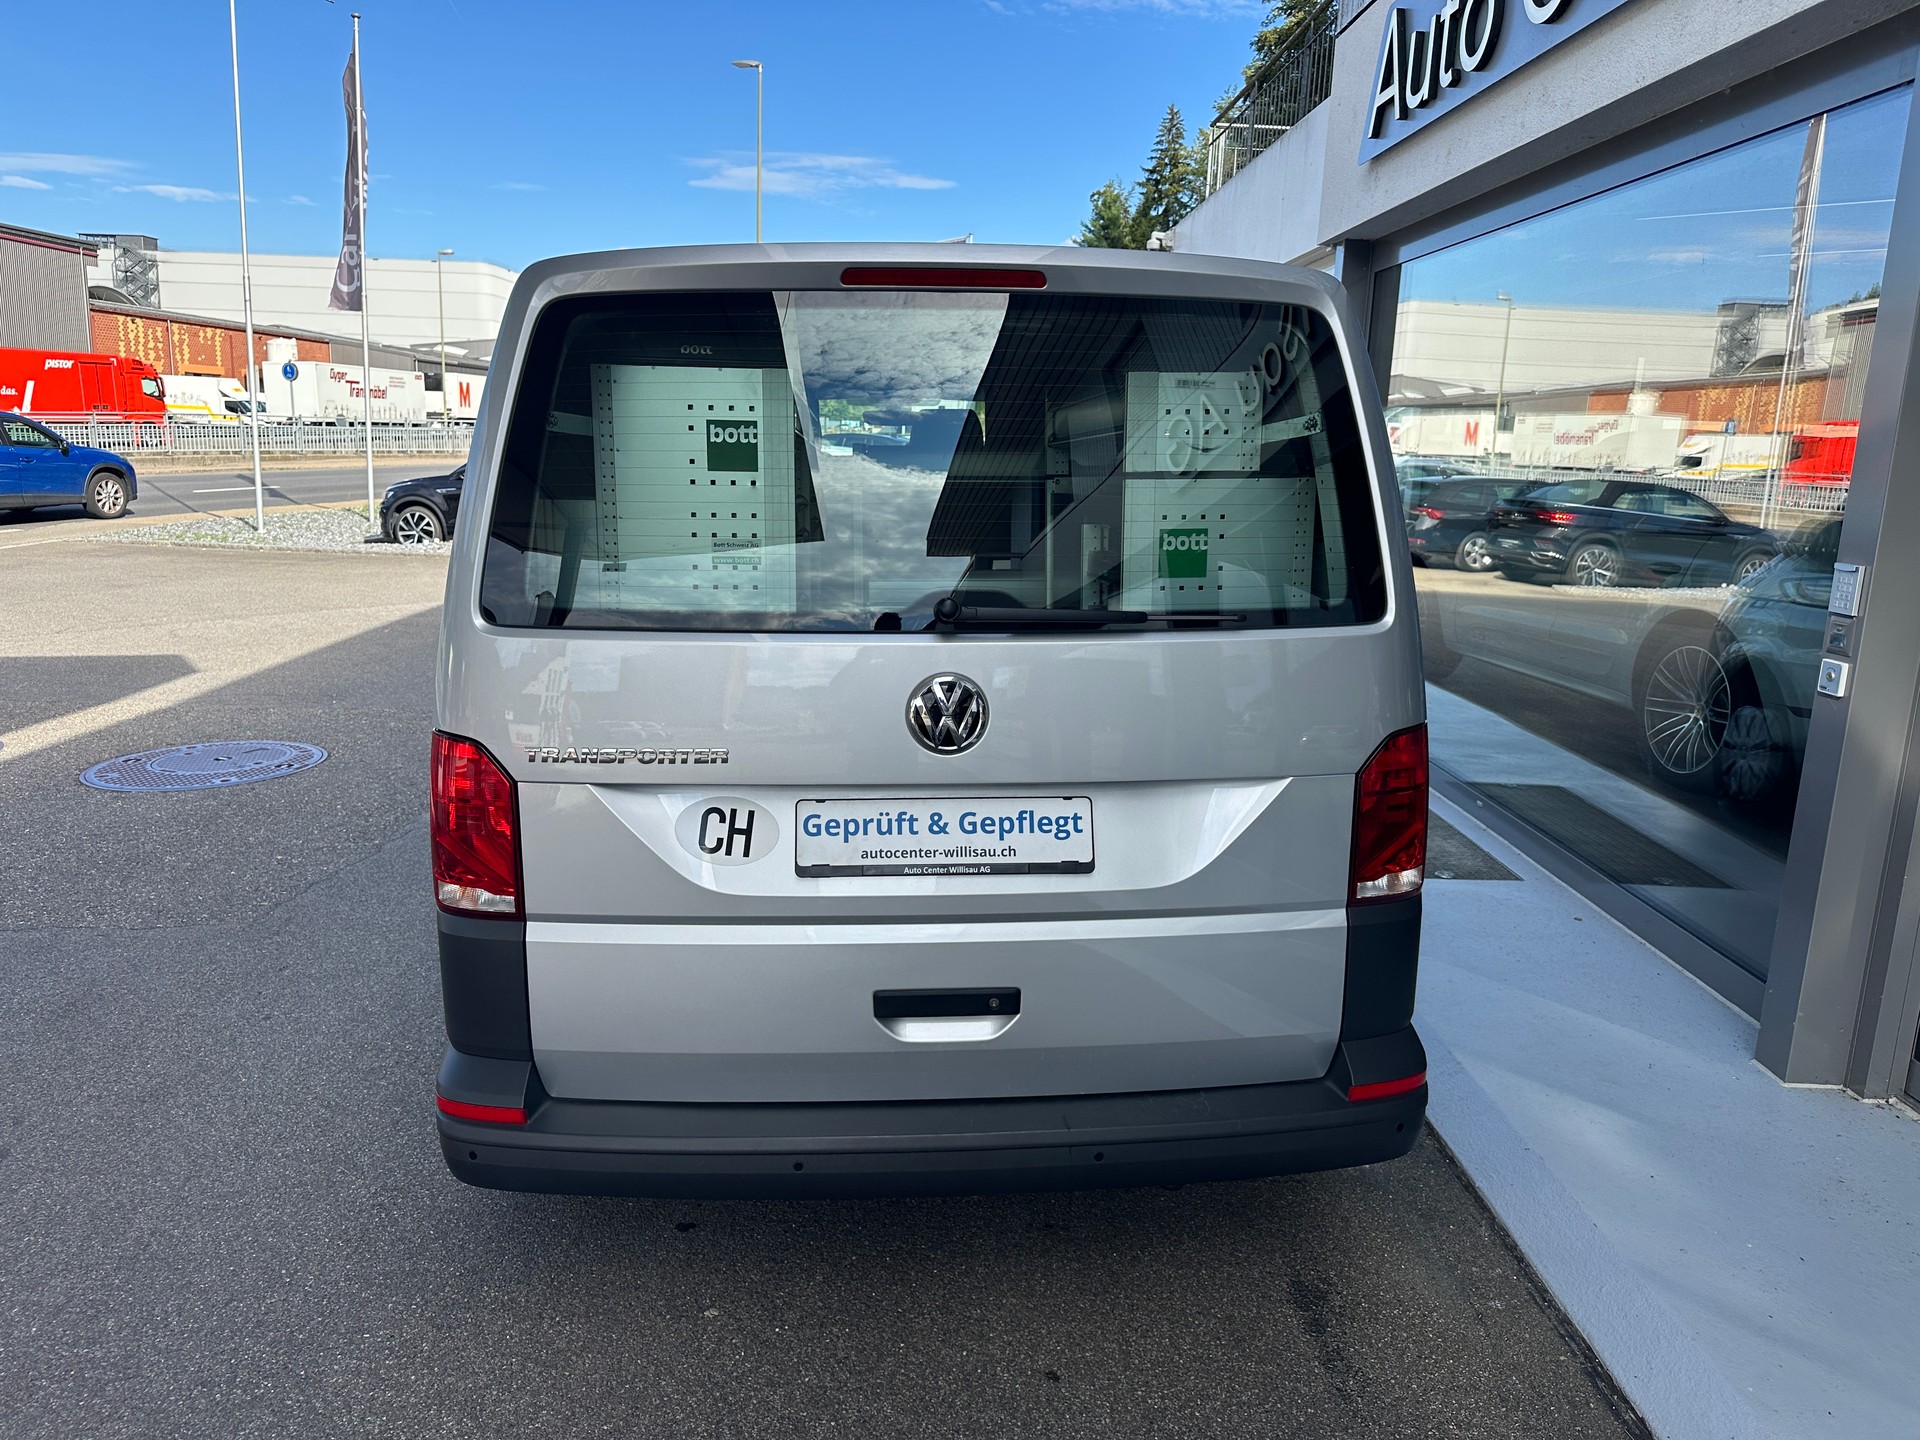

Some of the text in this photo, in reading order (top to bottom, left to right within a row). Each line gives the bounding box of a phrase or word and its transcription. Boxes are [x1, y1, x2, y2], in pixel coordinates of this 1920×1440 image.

[1368, 0, 1506, 139] Auto
[44, 358, 75, 371] pistor
[345, 380, 388, 399] Tranmöbel
[458, 381, 471, 408] M
[709, 424, 758, 443] bott
[1162, 533, 1208, 551] bott
[523, 746, 730, 764] TRANSPORTER
[698, 806, 756, 858] CH
[802, 810, 1084, 843] Geprüft & Gepflegt
[860, 845, 1017, 860] autocenter-willisau.ch
[903, 865, 991, 875] Auto Center Willisau AG
